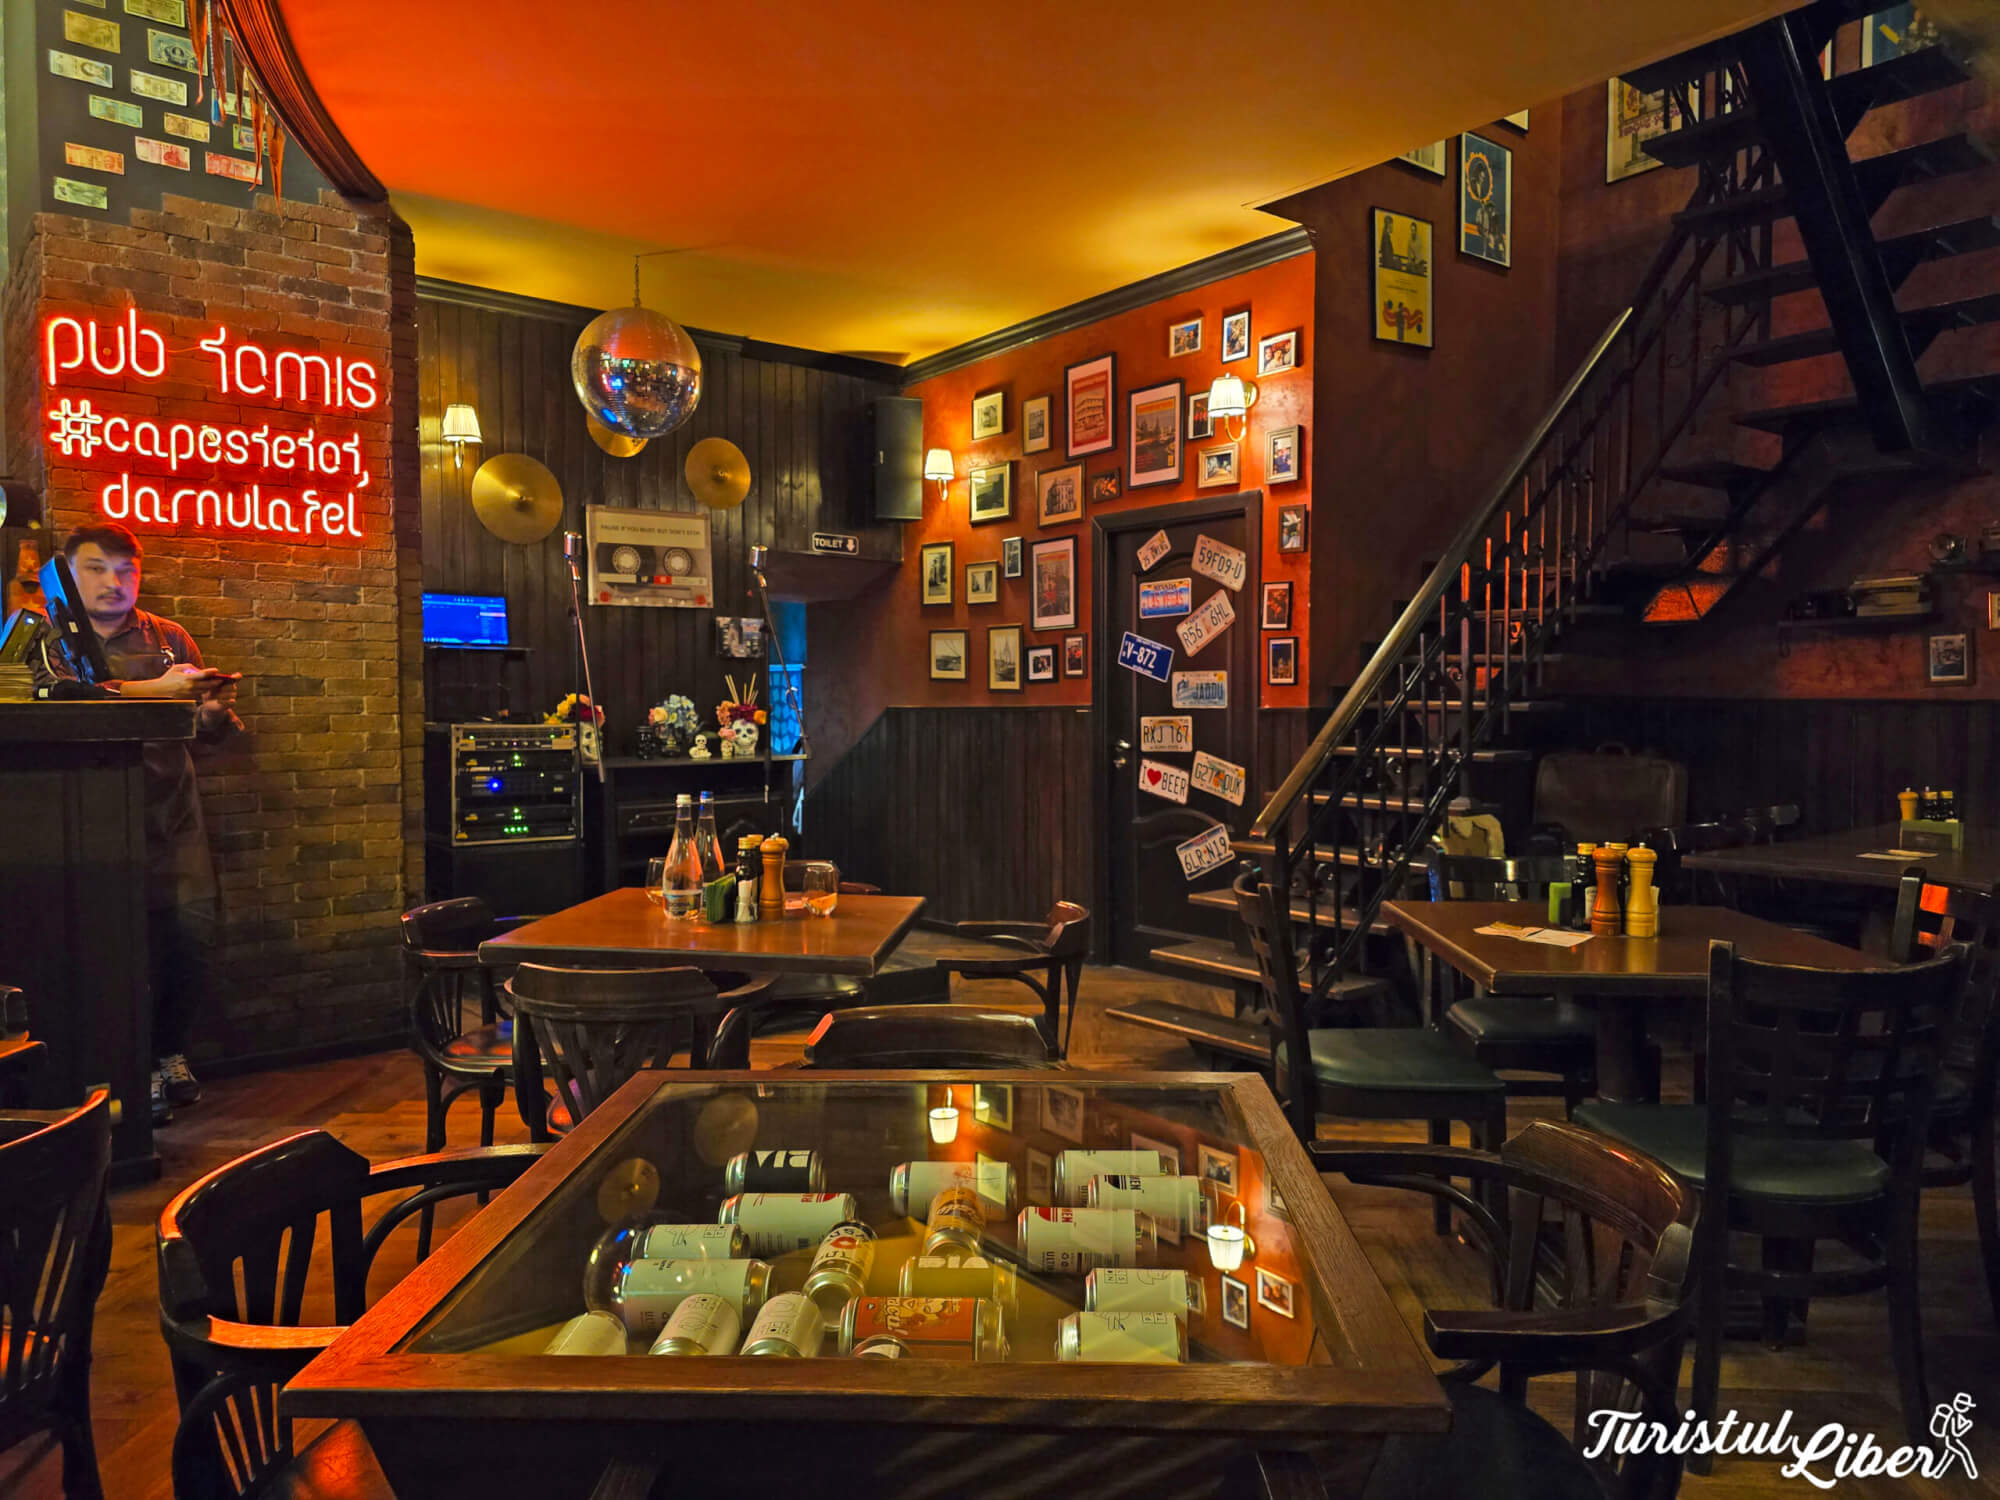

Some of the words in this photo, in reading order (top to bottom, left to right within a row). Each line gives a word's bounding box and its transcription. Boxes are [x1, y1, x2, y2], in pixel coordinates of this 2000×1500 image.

[47, 307, 165, 387] pub
[101, 473, 363, 537] darnulafel
[814, 537, 843, 549] TOILET
[1143, 725, 1164, 744] RXJ
[1142, 765, 1147, 784] I
[1161, 773, 1187, 798] BEER
